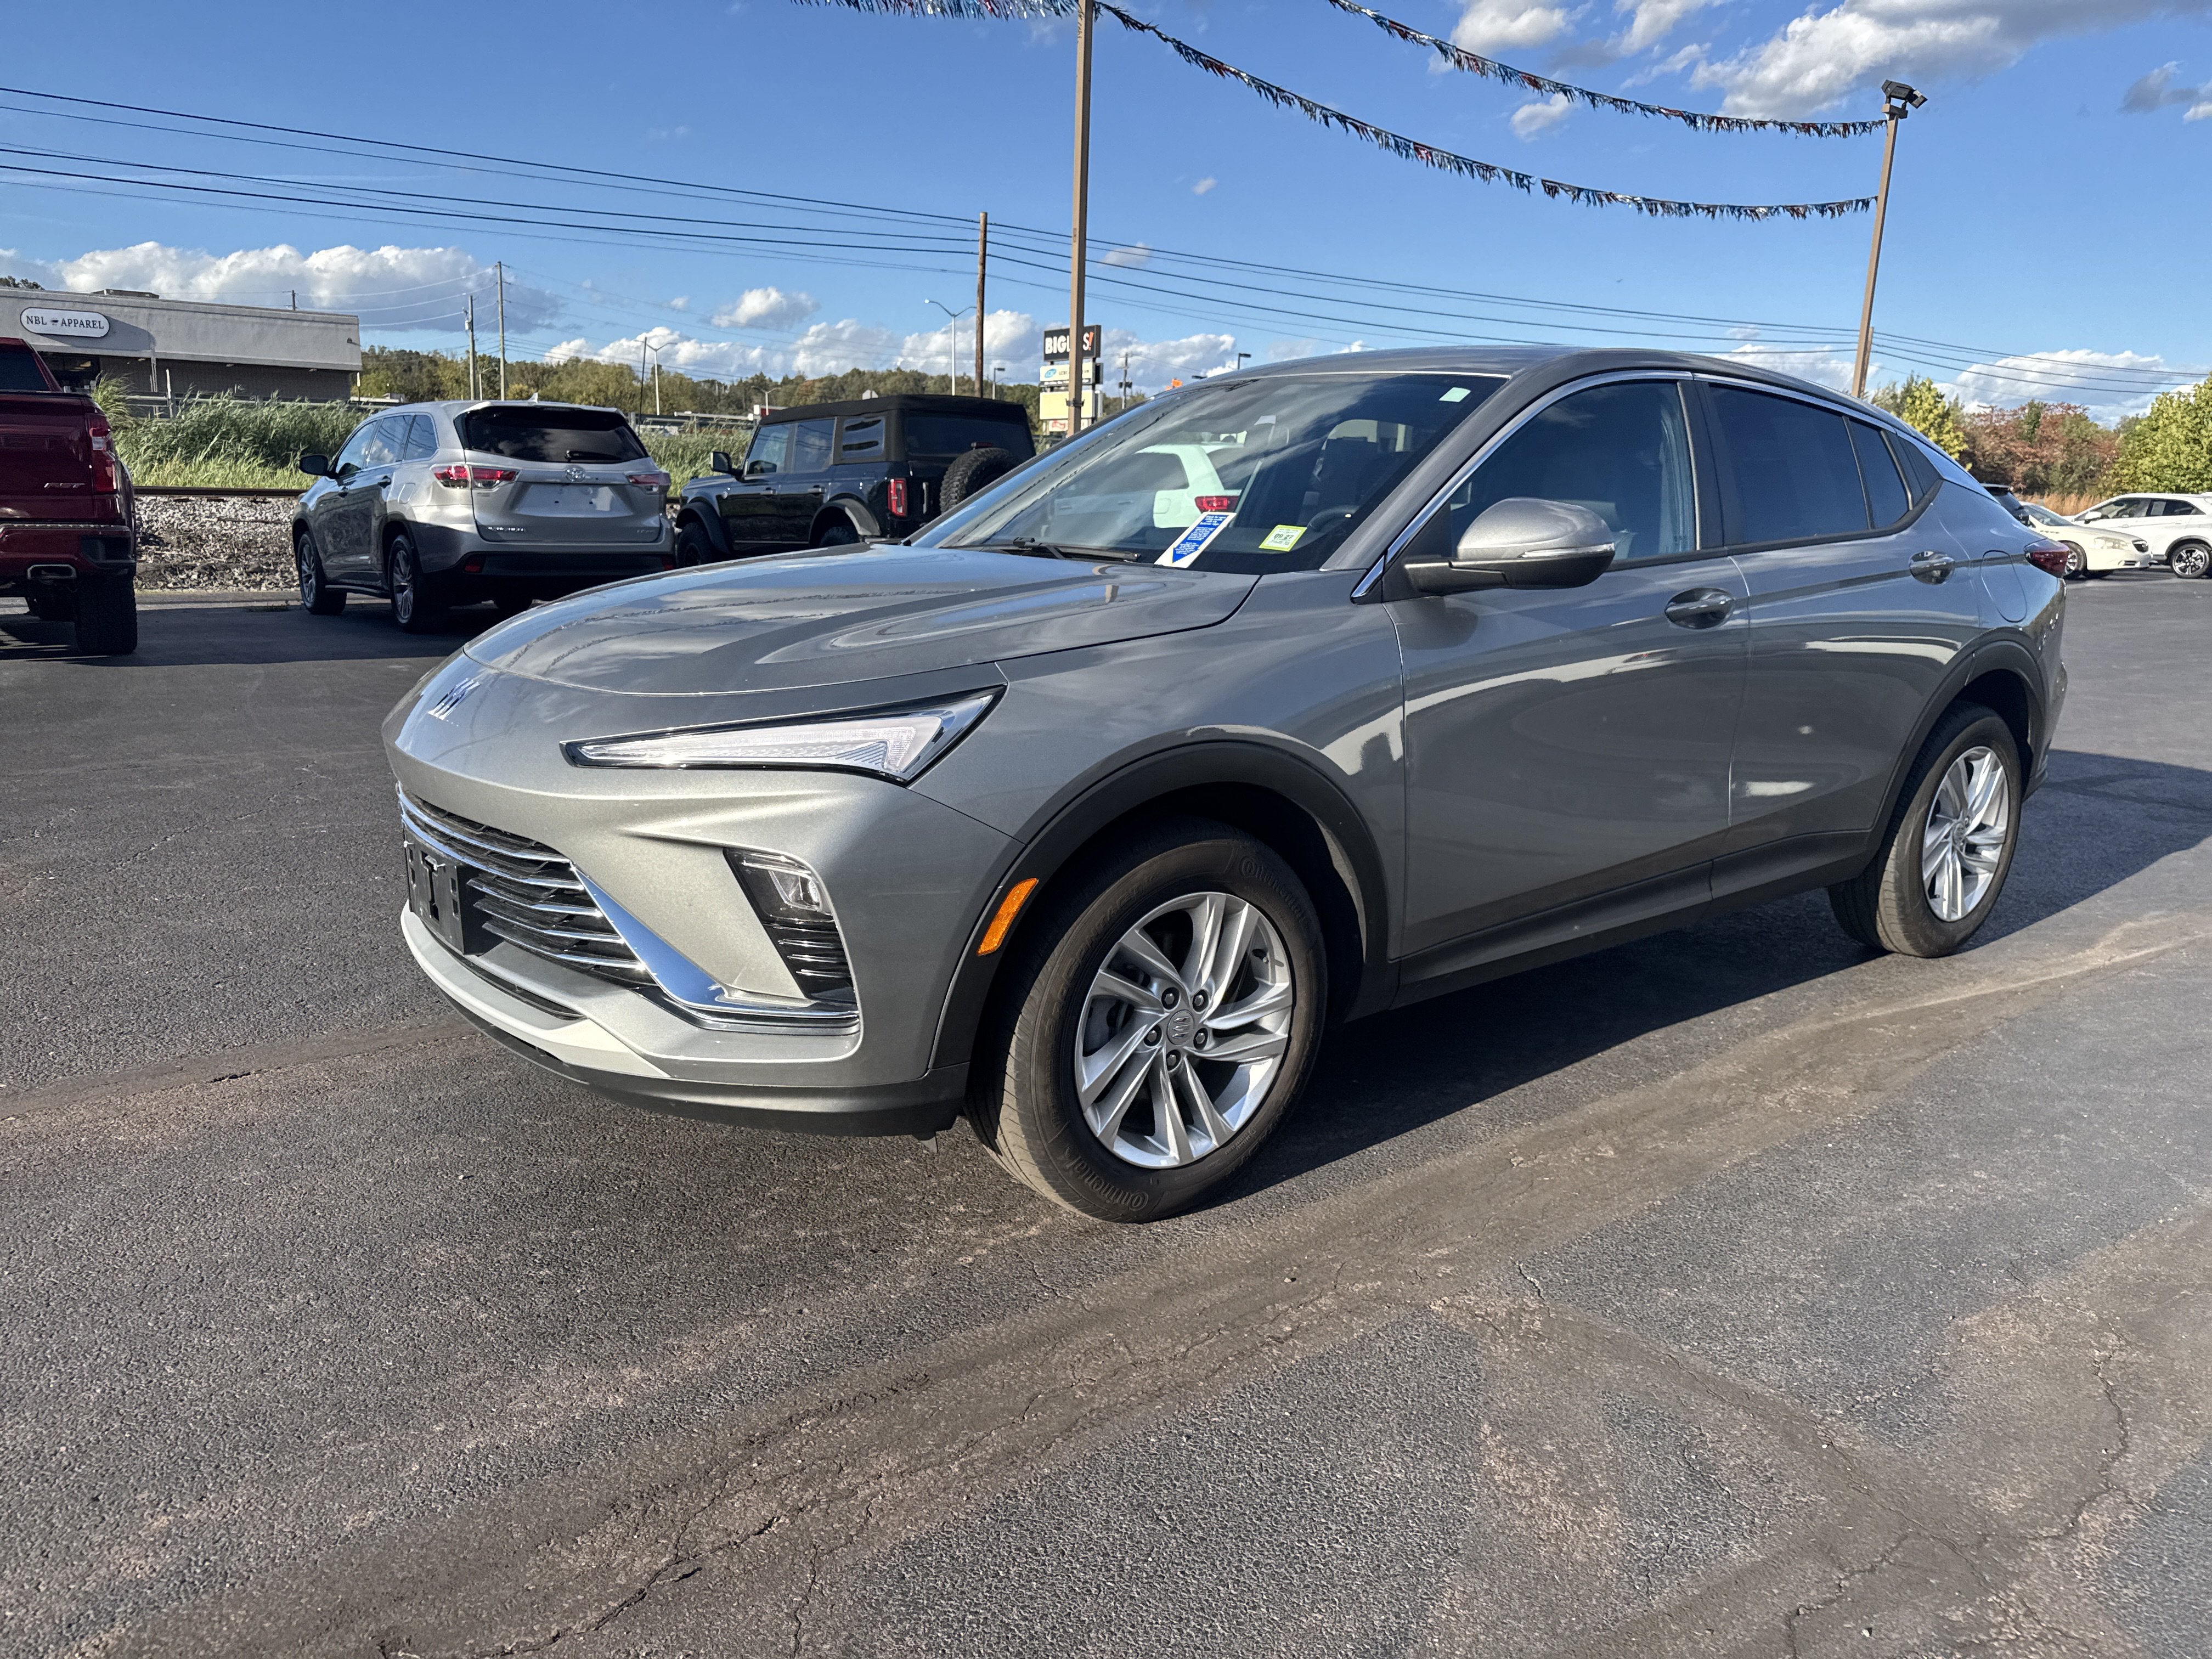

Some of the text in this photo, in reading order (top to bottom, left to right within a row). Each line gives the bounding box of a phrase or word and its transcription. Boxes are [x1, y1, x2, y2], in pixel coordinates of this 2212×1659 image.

[26, 315, 104, 329] NBL APPAREL
[1065, 1155, 1149, 1211] Continental
